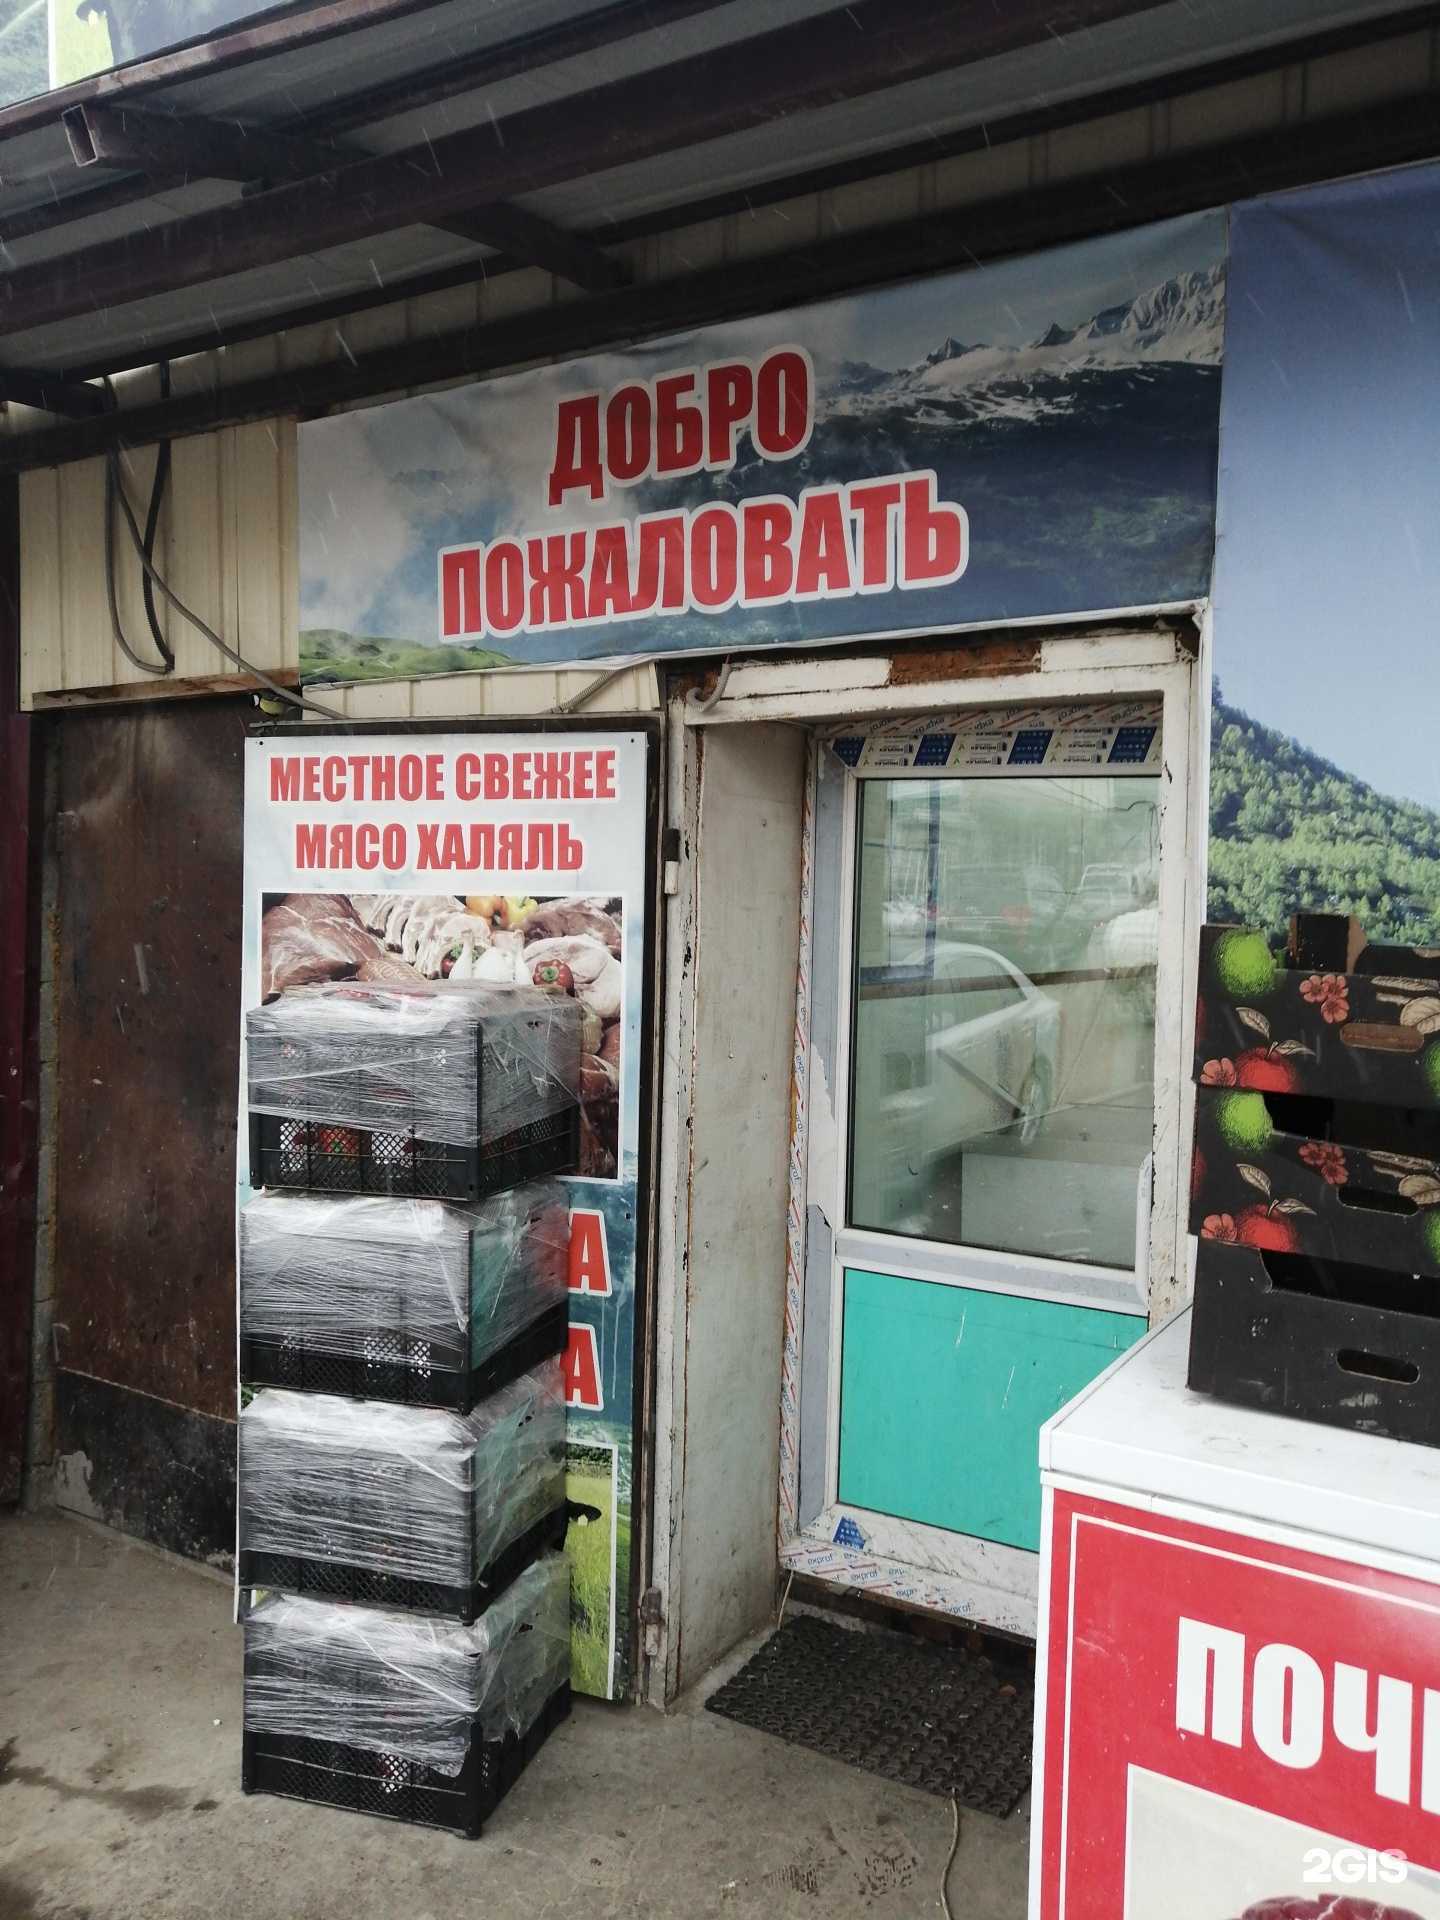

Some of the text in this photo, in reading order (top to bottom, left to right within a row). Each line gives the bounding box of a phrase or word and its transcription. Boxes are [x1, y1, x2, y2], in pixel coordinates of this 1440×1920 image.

[547, 349, 809, 508] ДОБРО
[441, 477, 964, 637] ПОЖАЛОВАТЬ
[270, 750, 616, 802] МЕСТНОЕ СВЕЖЕЕ
[296, 823, 583, 870] МЯСО ХАЛЯЛЬ
[1176, 1616, 1440, 1816] ПОЧ
